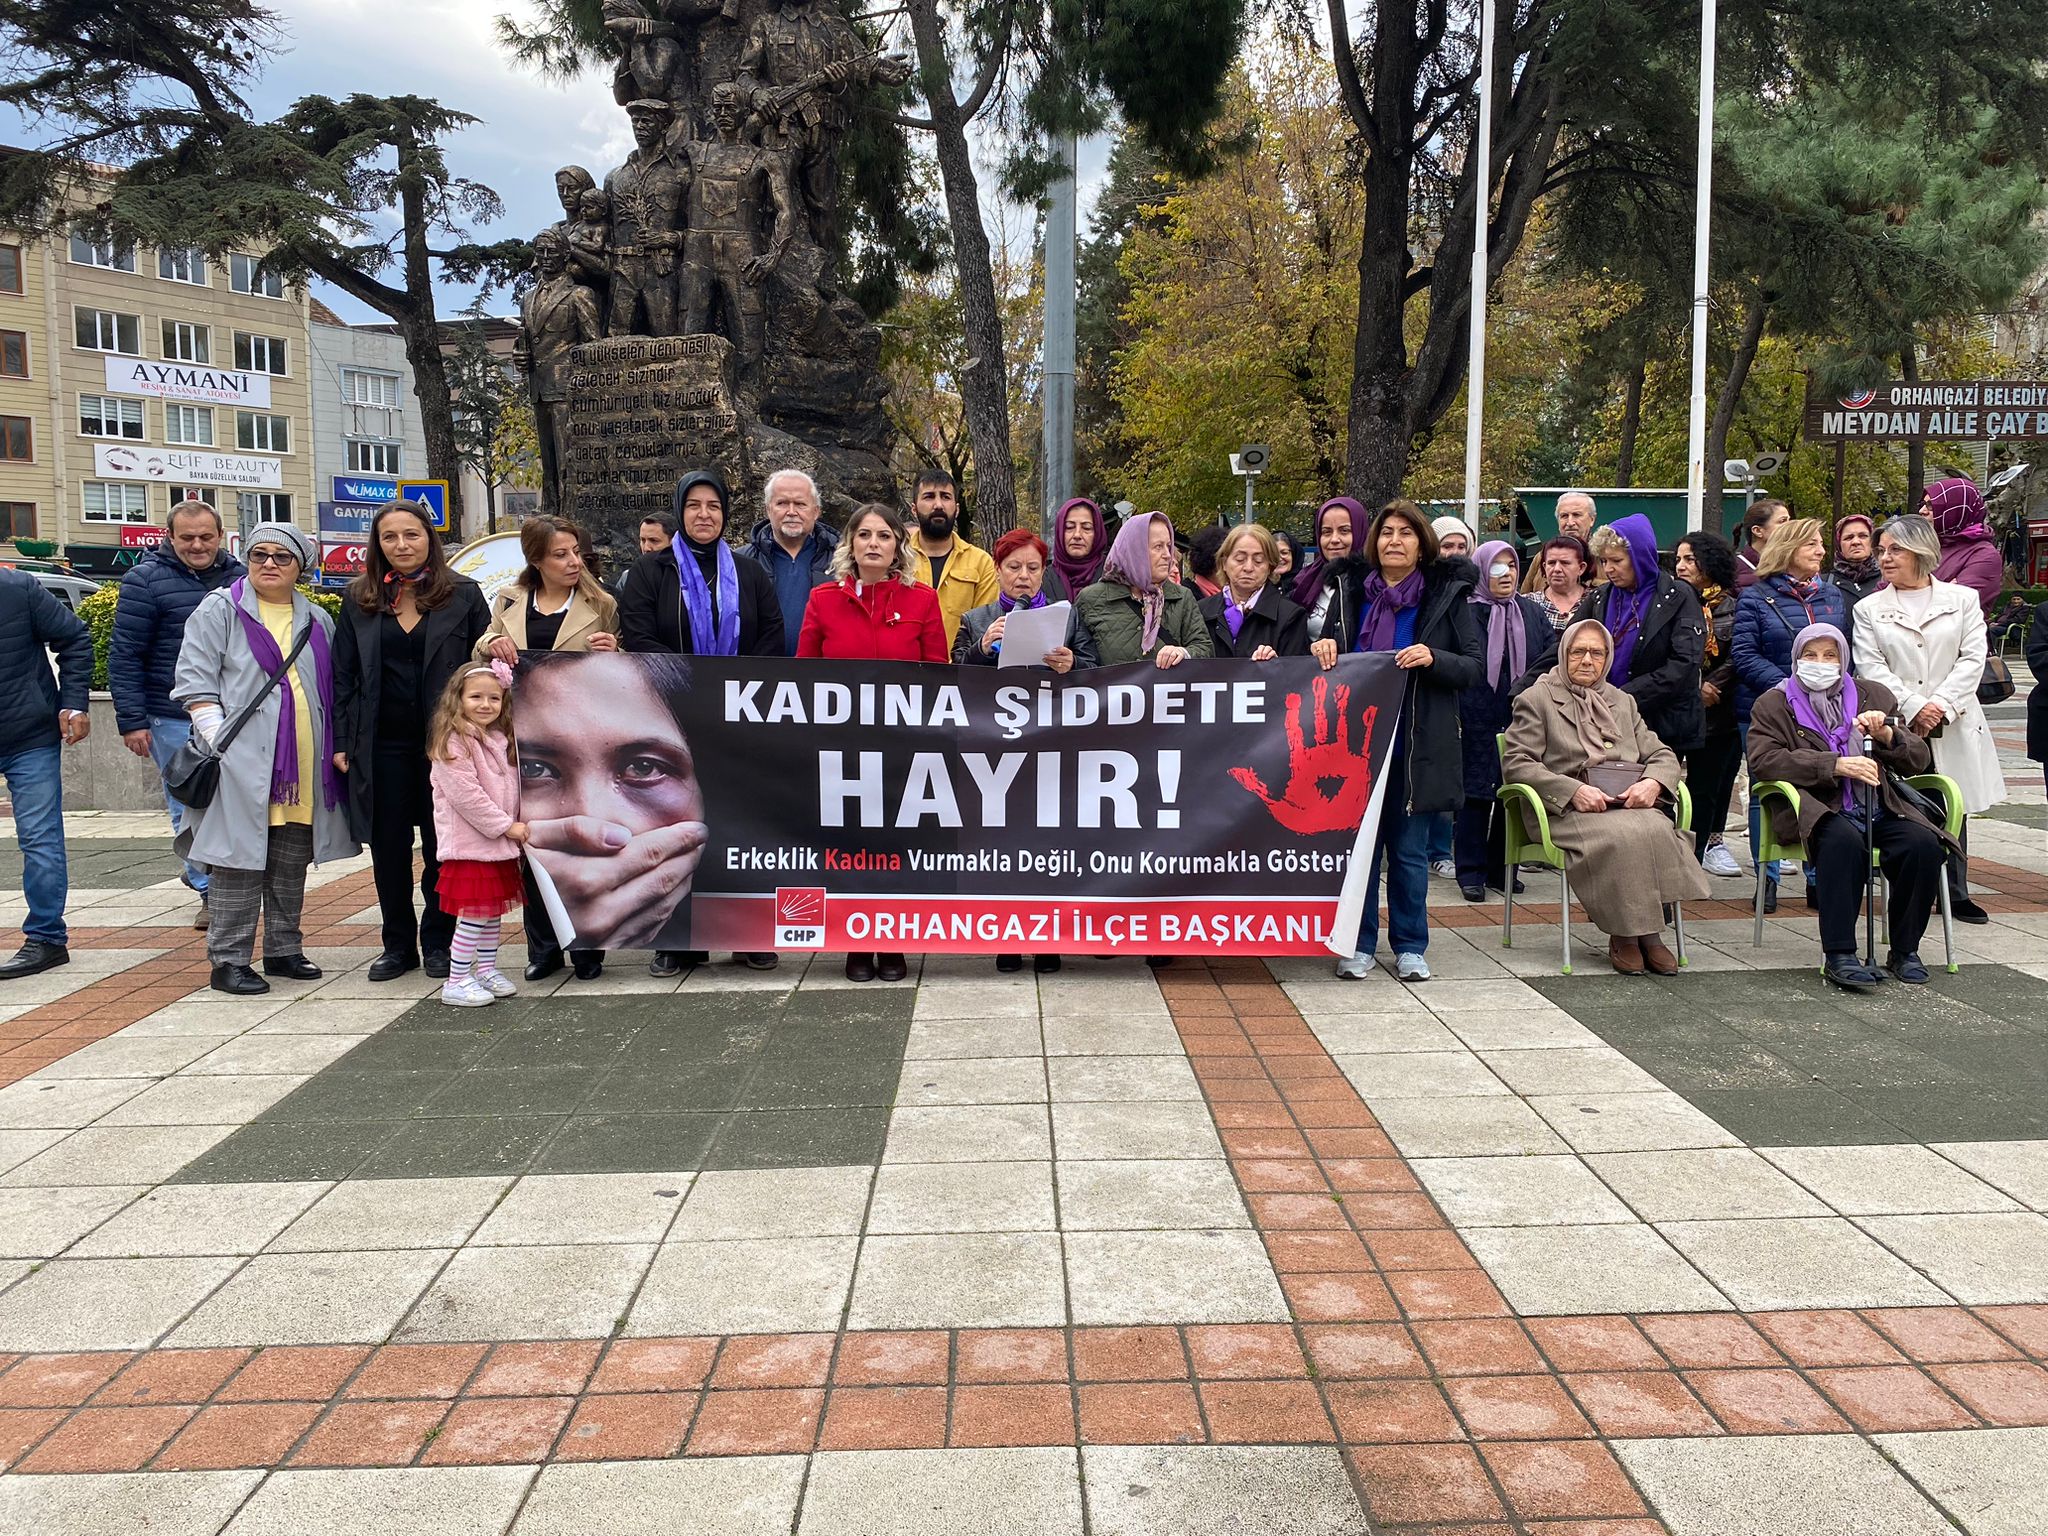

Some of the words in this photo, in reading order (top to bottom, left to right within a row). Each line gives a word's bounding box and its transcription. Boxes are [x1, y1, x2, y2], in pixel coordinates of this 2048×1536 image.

[572, 350, 586, 366] ey
[590, 344, 645, 365] yükselen
[131, 363, 249, 393] AYMANİ
[570, 372, 620, 391] gelecek
[627, 366, 676, 385] sizindir
[141, 382, 167, 393] RESİM
[168, 385, 174, 393] &
[176, 386, 201, 396] SANAT
[206, 389, 241, 400] ATÖLYESİ
[572, 390, 648, 413] cumhuriyeti
[1890, 382, 1979, 406] ORHANGAZİ
[1983, 382, 2048, 407] BELEDİY
[1822, 411, 1920, 435] MEYDAN
[1927, 405, 1978, 435] AİLE
[1986, 411, 2030, 441] ÇAY
[189, 471, 209, 480] BAYAN
[210, 472, 237, 482] GÜZELLİK
[214, 457, 280, 474] BEAUTY
[124, 536, 135, 545] 1.
[136, 536, 163, 546] NOT
[724, 679, 970, 728] KADINA
[993, 680, 1267, 739] ŞİDDETE
[818, 749, 1182, 829] HAYIR!
[726, 847, 818, 870] Erkeklik
[824, 848, 901, 871] Kadına
[907, 848, 1011, 873] Vurmakla
[1017, 849, 1084, 877] Değil,
[1089, 850, 1133, 874] Onu
[1140, 850, 1260, 875] Korumakla
[783, 929, 817, 942] CHP
[845, 908, 1060, 942] ORHANGAZİ
[1072, 908, 1148, 947] İLÇE
[1160, 914, 1330, 947] BAŞKANL
